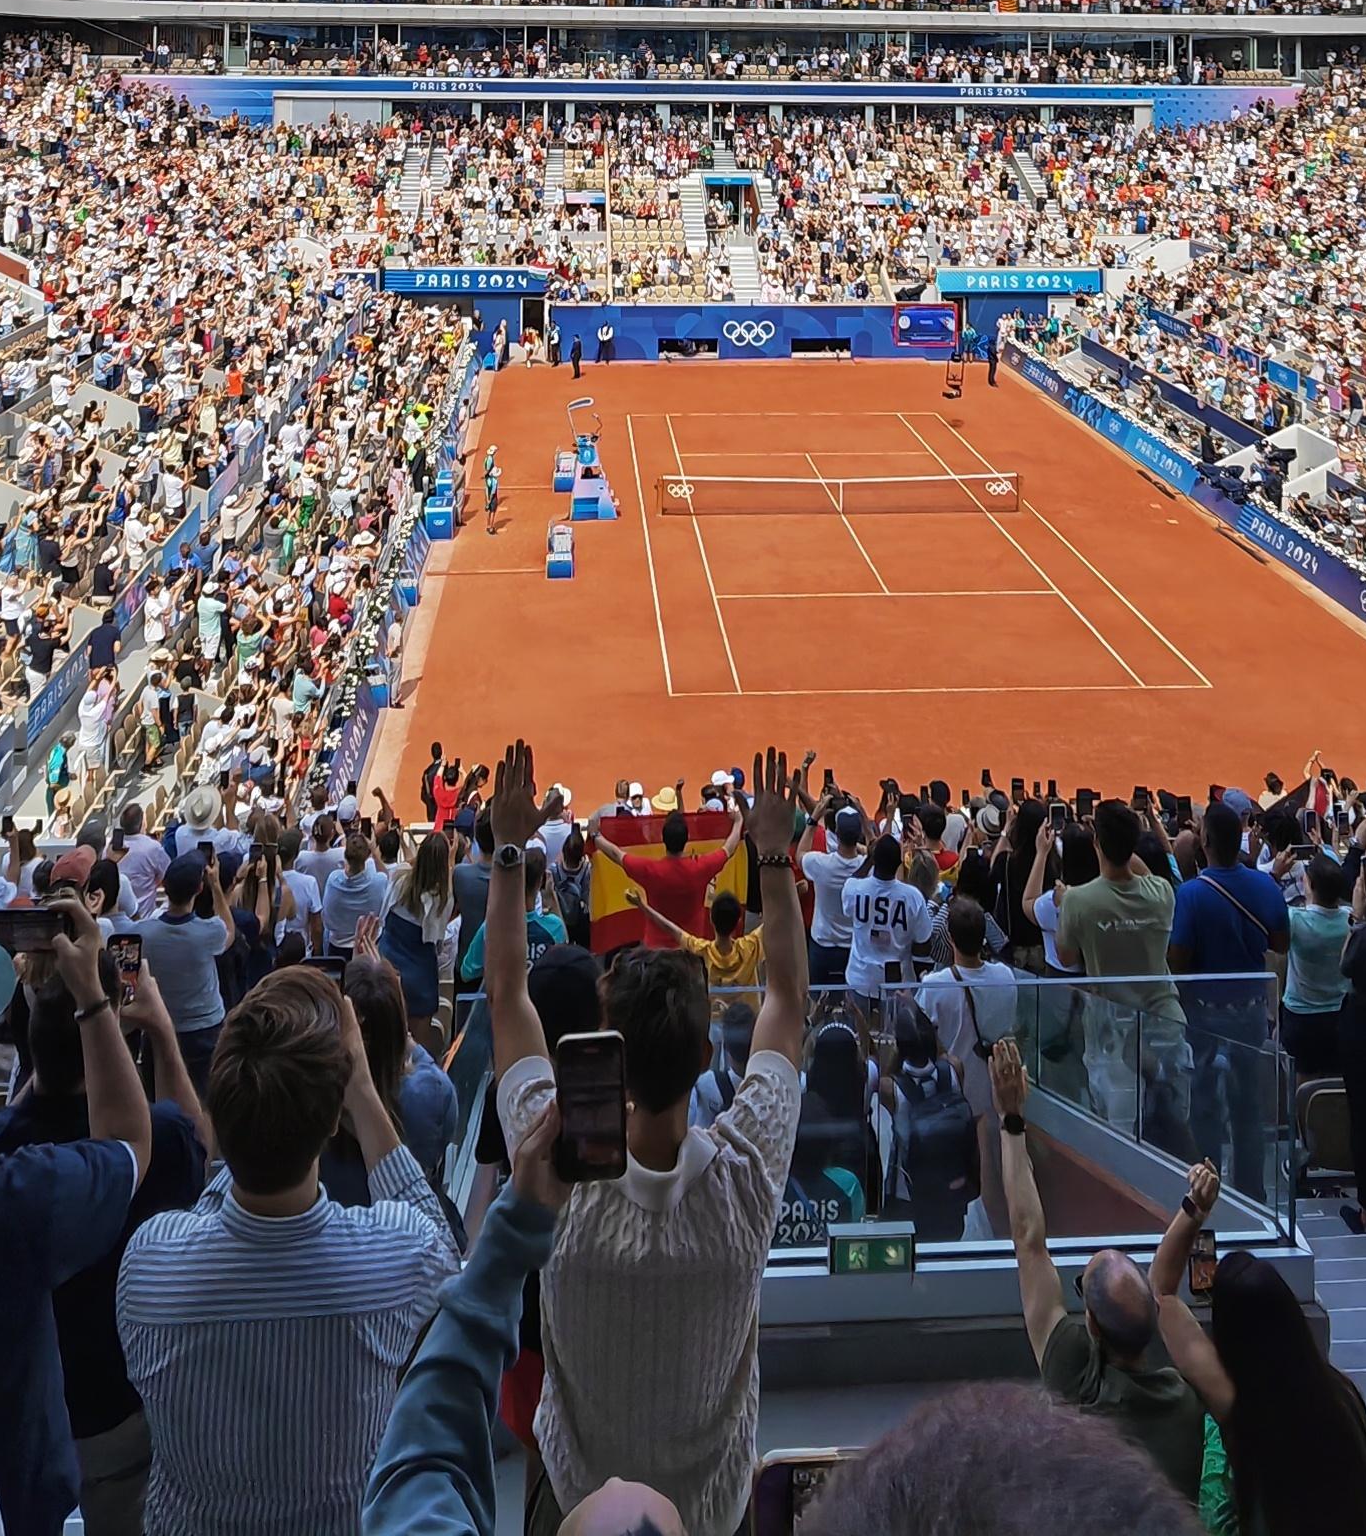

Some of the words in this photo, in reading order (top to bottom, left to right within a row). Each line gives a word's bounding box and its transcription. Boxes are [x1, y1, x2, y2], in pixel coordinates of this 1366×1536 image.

[412, 81, 447, 91] PARIS
[451, 82, 483, 91] 2024
[960, 87, 994, 96] PARIS
[996, 87, 1027, 96] 2024
[415, 274, 470, 289] PARIS
[477, 274, 527, 289] 2024
[966, 275, 1019, 289] PARIS
[1025, 275, 1073, 289] 2024
[1135, 438, 1161, 463] PARIS
[1159, 453, 1183, 478] 2024
[1250, 518, 1285, 550] PARIS
[1285, 540, 1319, 575] 2024
[35, 678, 64, 724] PARIS
[348, 707, 369, 761] 2024
[855, 894, 908, 932] USA
[777, 1222, 828, 1244] 202
